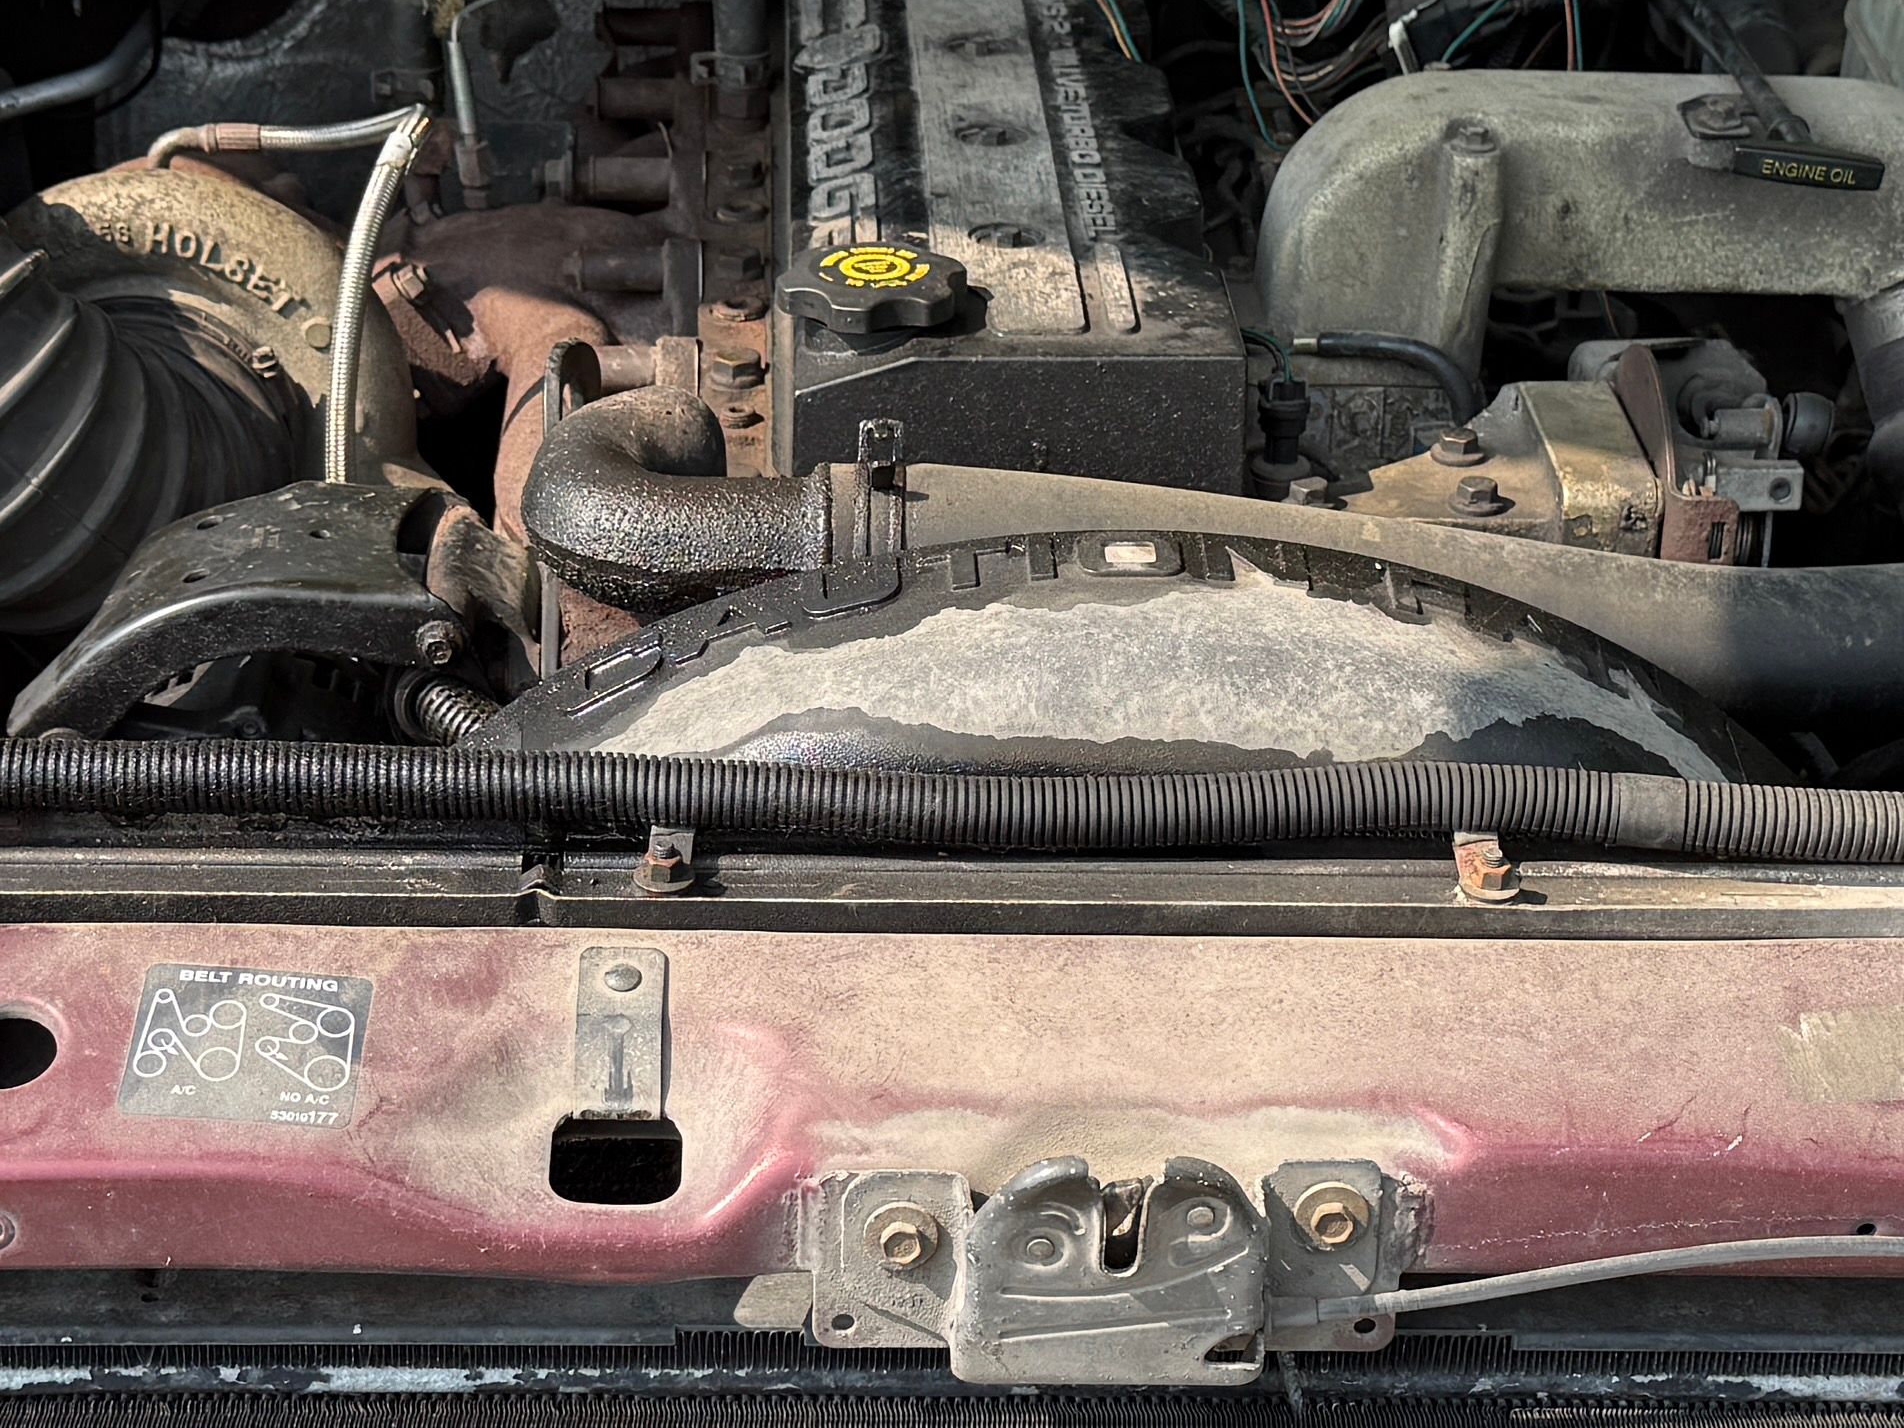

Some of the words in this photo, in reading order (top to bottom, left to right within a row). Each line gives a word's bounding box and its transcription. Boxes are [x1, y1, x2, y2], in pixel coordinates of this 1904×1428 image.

[1061, 102, 1102, 164] TURBO
[1762, 159, 1827, 181] ENGINE
[1830, 168, 1856, 185] OIL
[1074, 169, 1118, 238] DIESEL
[145, 221, 308, 313] HOLSET
[179, 969, 233, 984] BELT
[238, 972, 339, 993] ROUTING
[170, 1084, 197, 1096] A/C
[279, 1091, 302, 1104] NO
[304, 1094, 330, 1106] A/C
